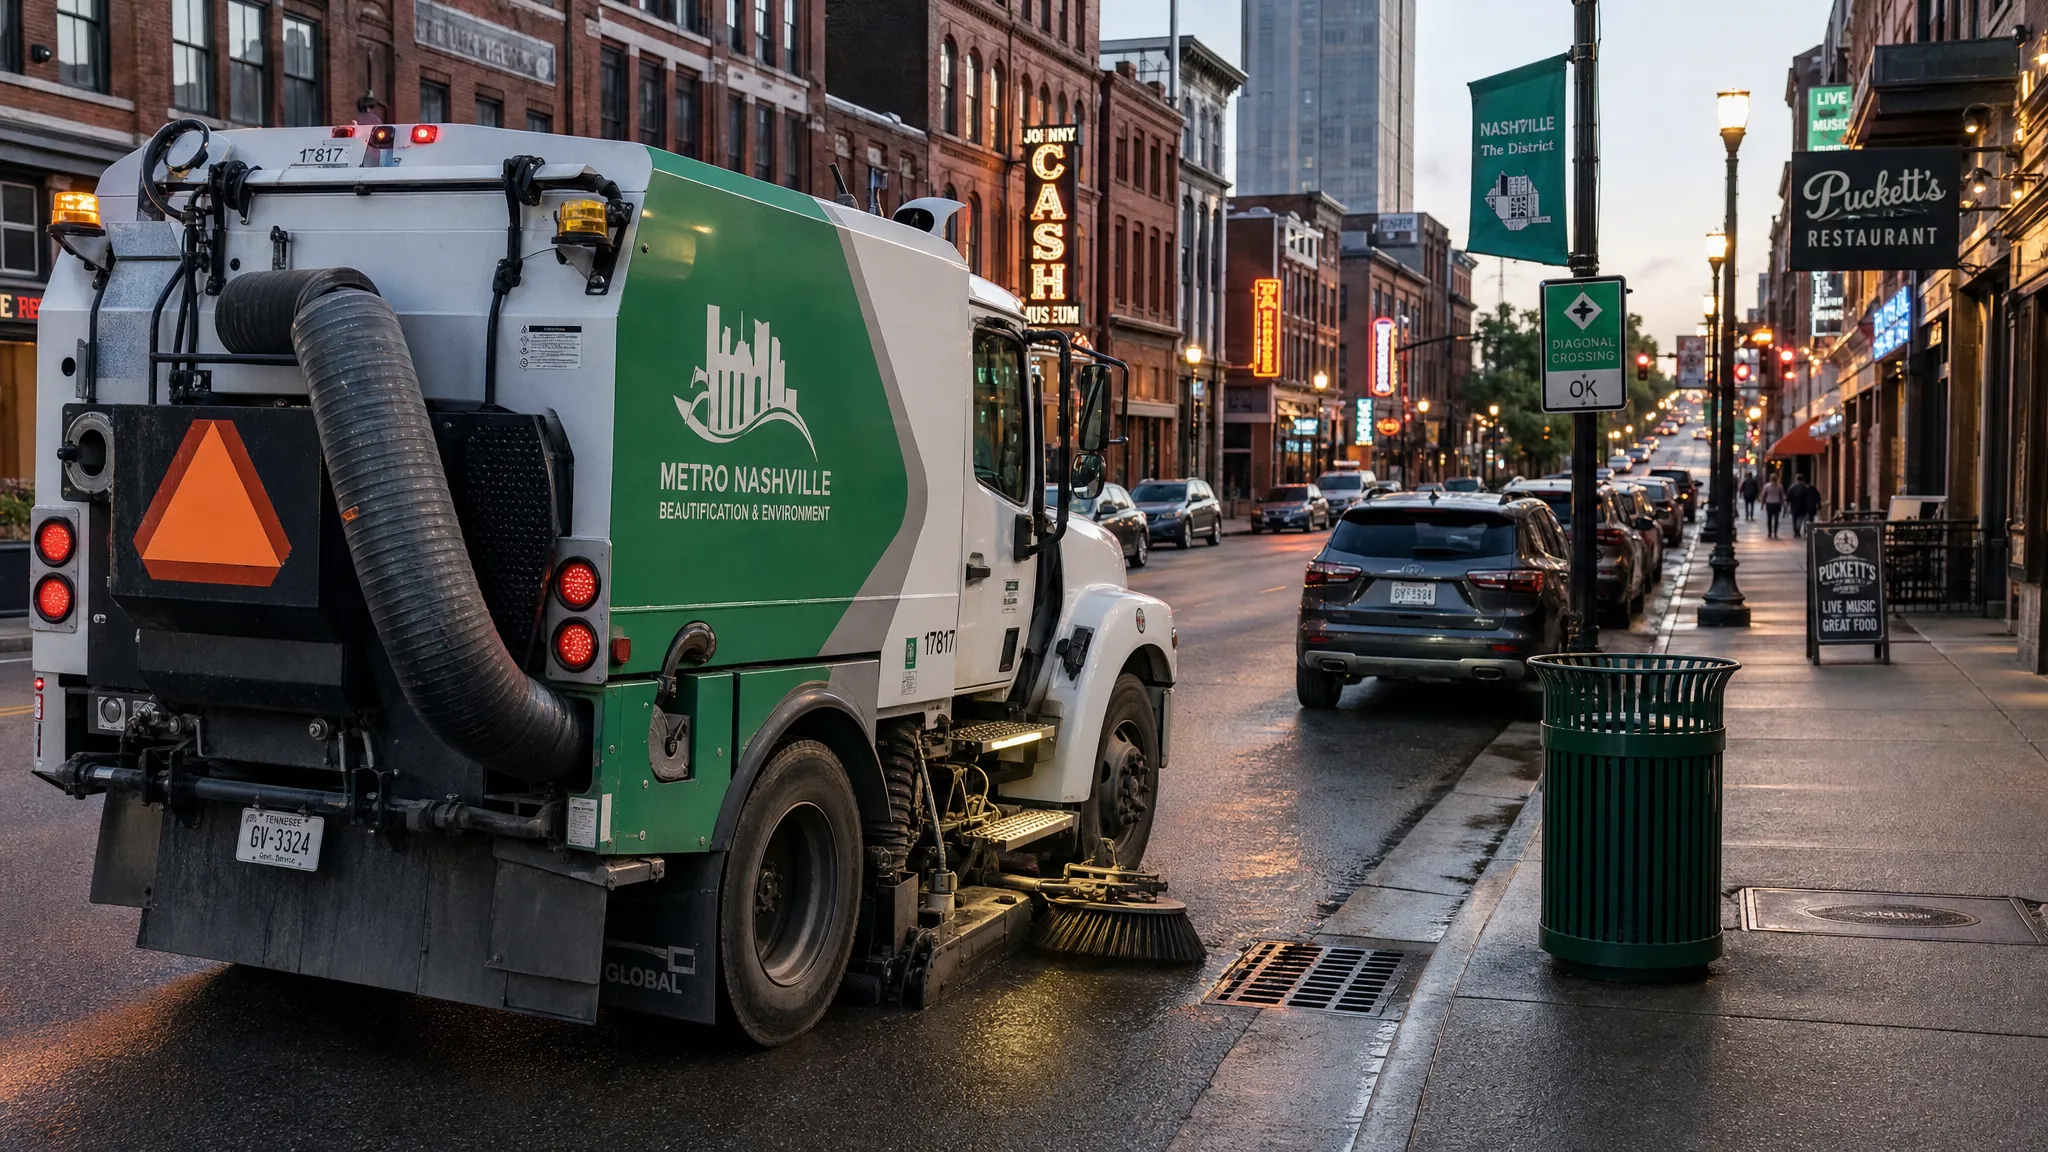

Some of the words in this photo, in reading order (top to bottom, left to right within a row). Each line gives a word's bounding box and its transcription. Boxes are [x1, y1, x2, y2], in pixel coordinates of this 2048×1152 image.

[1817, 92, 1848, 105] LIVE
[1480, 116, 1555, 137] NASHVILLE
[1813, 118, 1849, 131] MUSIC
[1023, 127, 1075, 144] JOHNNY
[300, 148, 344, 163] 17817
[1481, 144, 1504, 156] The
[1508, 140, 1555, 155] District
[1803, 168, 1946, 222] Puckett's
[1030, 144, 1067, 300] CASH
[1808, 227, 1938, 247] RESTAURANT
[1552, 337, 1615, 350] DIAGONAL
[1552, 351, 1615, 364] CROSSING
[1569, 379, 1598, 398] OK
[660, 462, 729, 493] METRO
[734, 465, 832, 496] NASHVILLE
[659, 501, 749, 521] BEAUTIFICATION
[751, 504, 759, 521] &
[761, 504, 831, 522] ENVIRONMENT
[1819, 561, 1876, 582] PUCKETT'S
[1822, 600, 1843, 614] LIVE
[1846, 600, 1876, 613] MUSIC
[1823, 619, 1850, 631] GREAT
[1854, 619, 1877, 631] FOOD
[924, 629, 956, 656] 17817
[251, 825, 310, 855] GV-3324
[605, 963, 682, 994] GLOBAL
